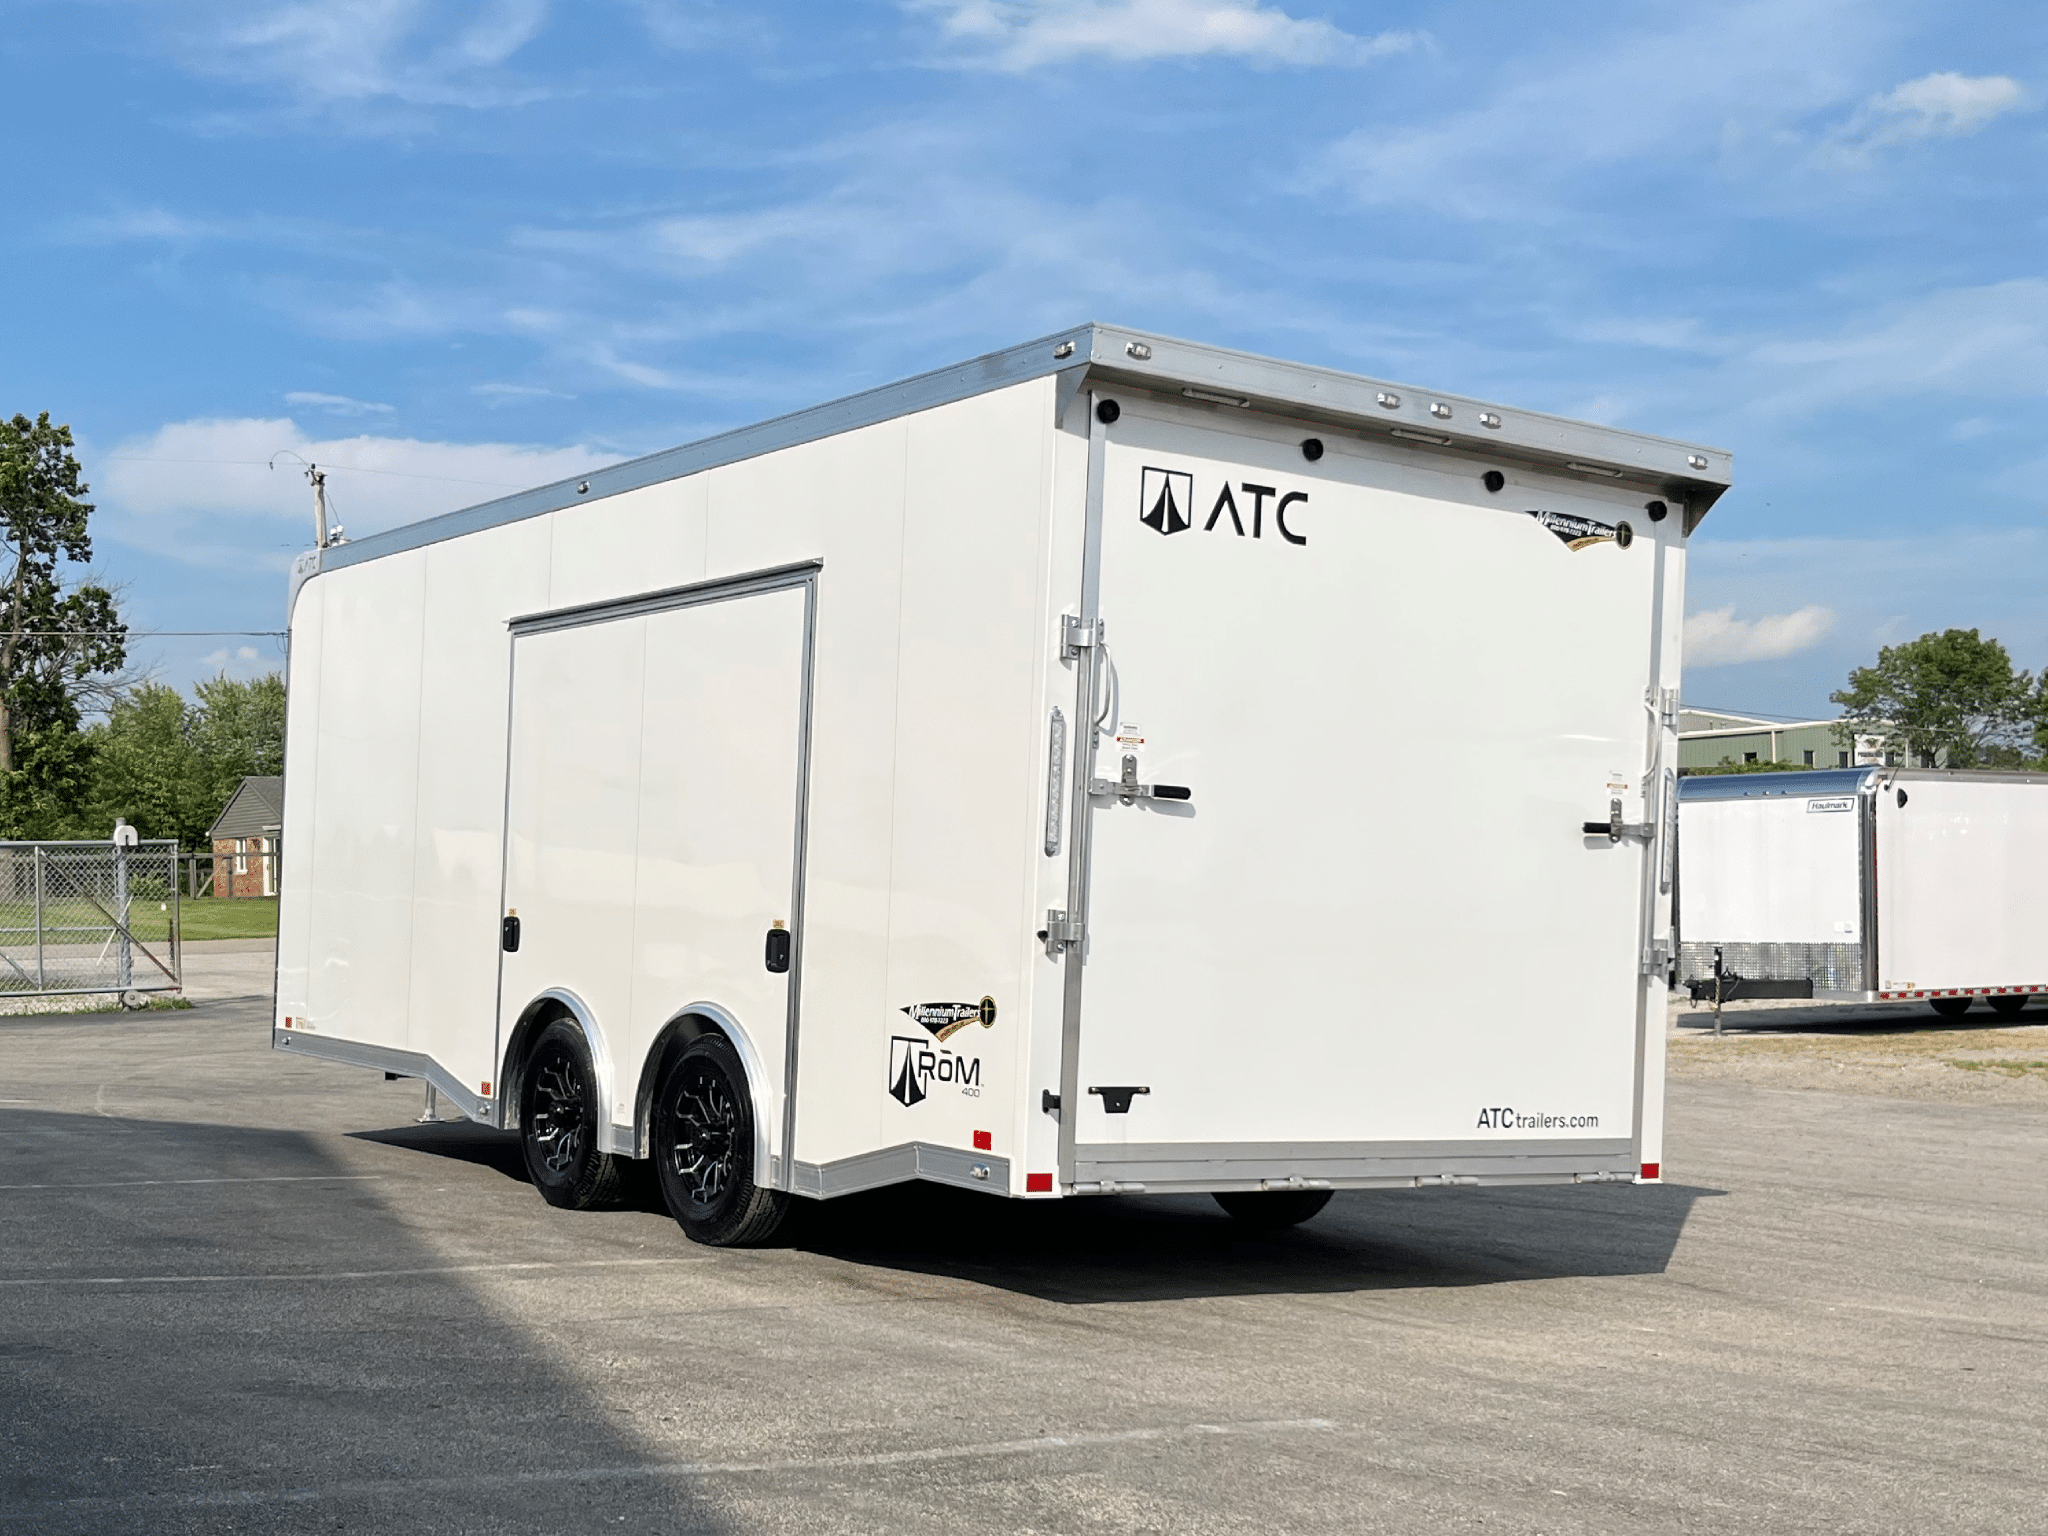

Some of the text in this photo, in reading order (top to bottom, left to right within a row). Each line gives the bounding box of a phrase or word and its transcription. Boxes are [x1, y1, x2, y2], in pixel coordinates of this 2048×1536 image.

[1203, 480, 1308, 546] ATC
[1812, 801, 1848, 810] Haulmark
[961, 1087, 980, 1098] 400
[1476, 1107, 1599, 1129] ATCtrailers.com
